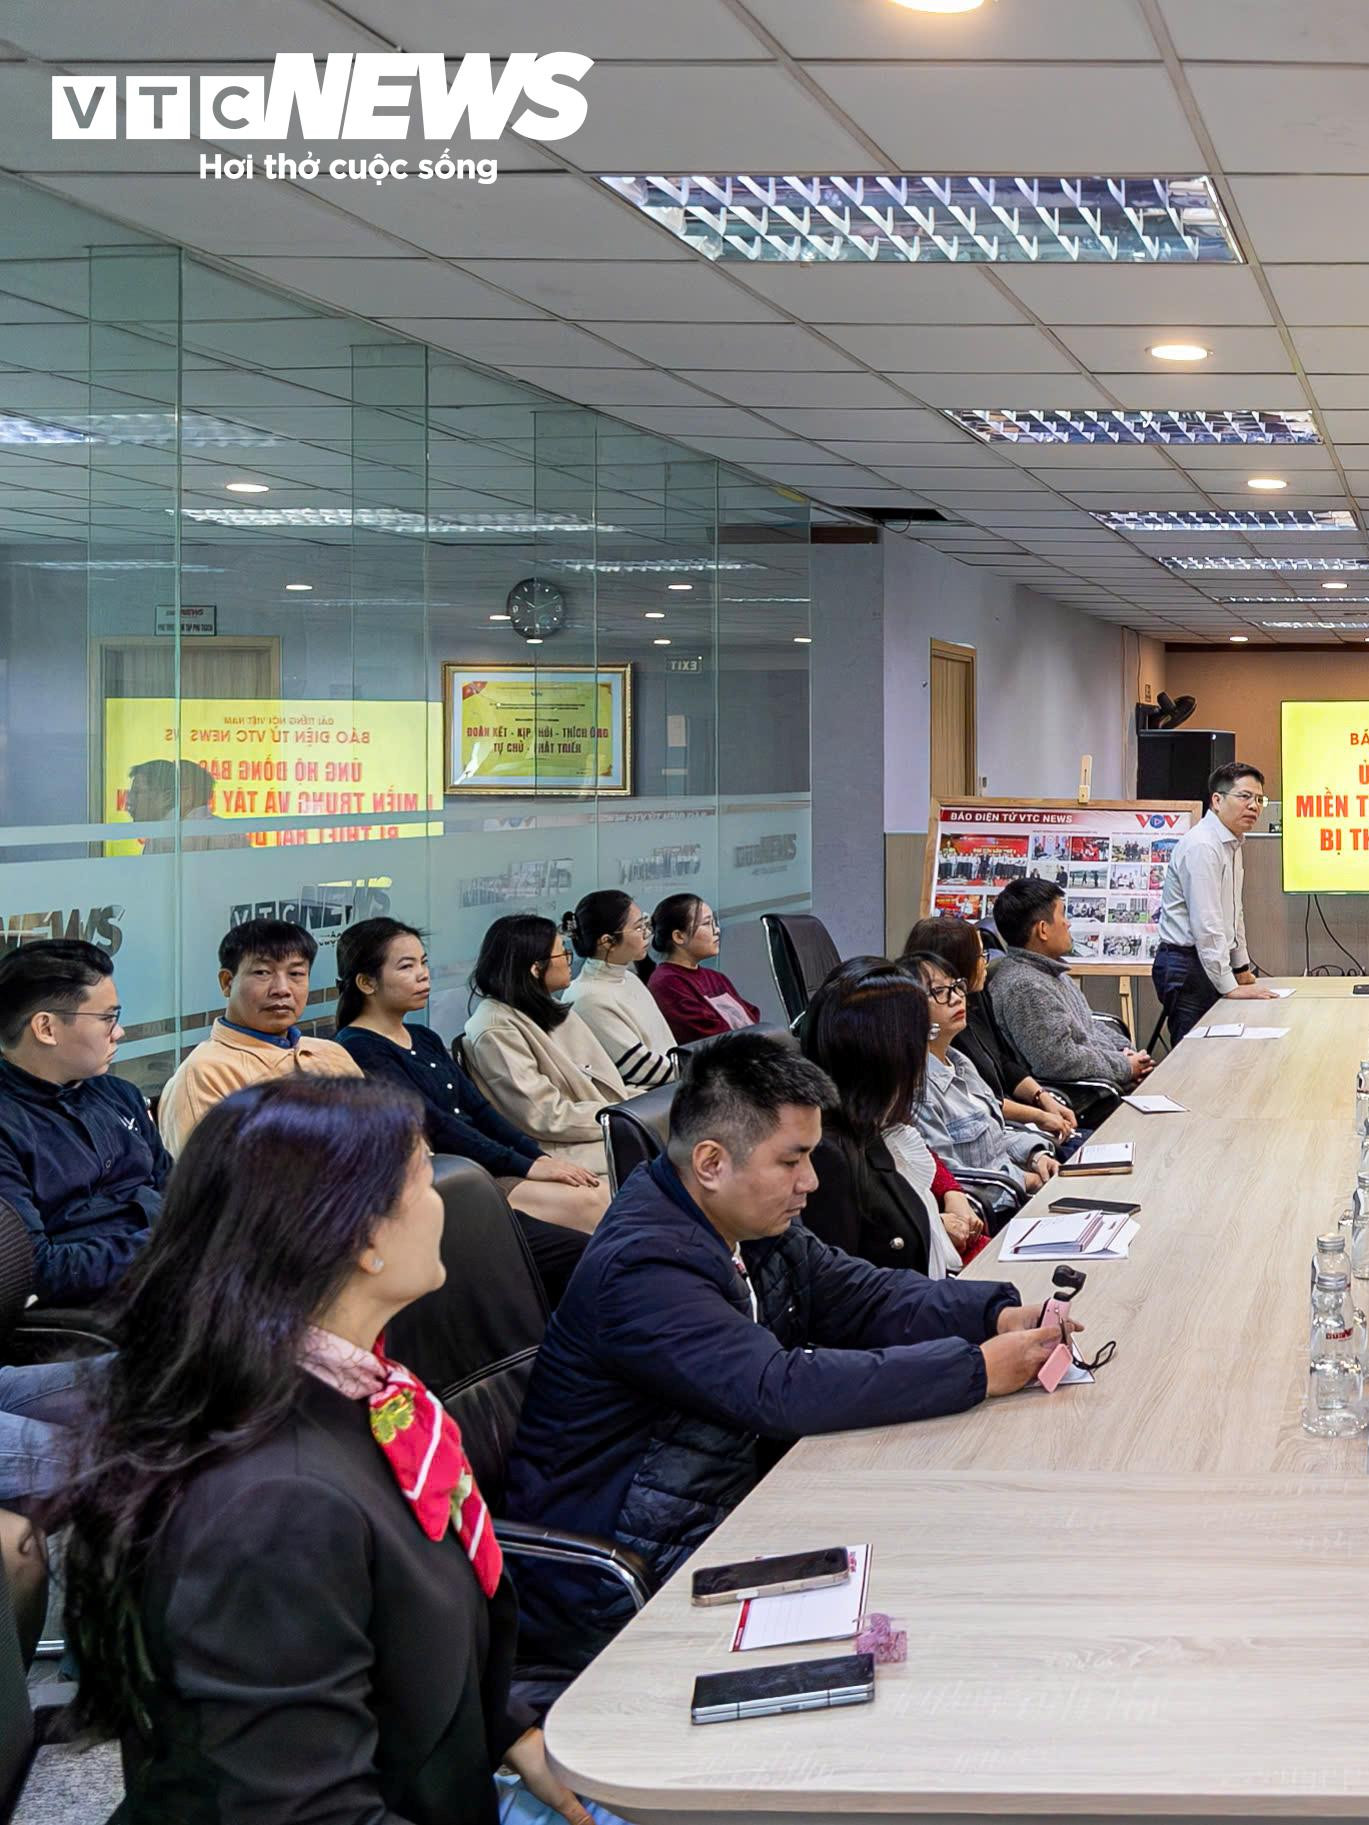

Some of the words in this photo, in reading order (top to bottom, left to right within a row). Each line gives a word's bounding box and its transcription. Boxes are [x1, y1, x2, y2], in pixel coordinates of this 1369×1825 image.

[1296, 787, 1349, 817] MIỀN
[950, 810, 973, 821] BÁO
[975, 812, 999, 823] ĐIỆN
[1001, 811, 1017, 823] TỬ
[1019, 814, 1041, 823] VTC
[1043, 814, 1073, 824] NEWS
[1135, 814, 1181, 829] VOV
[1320, 828, 1342, 855] BỊ
